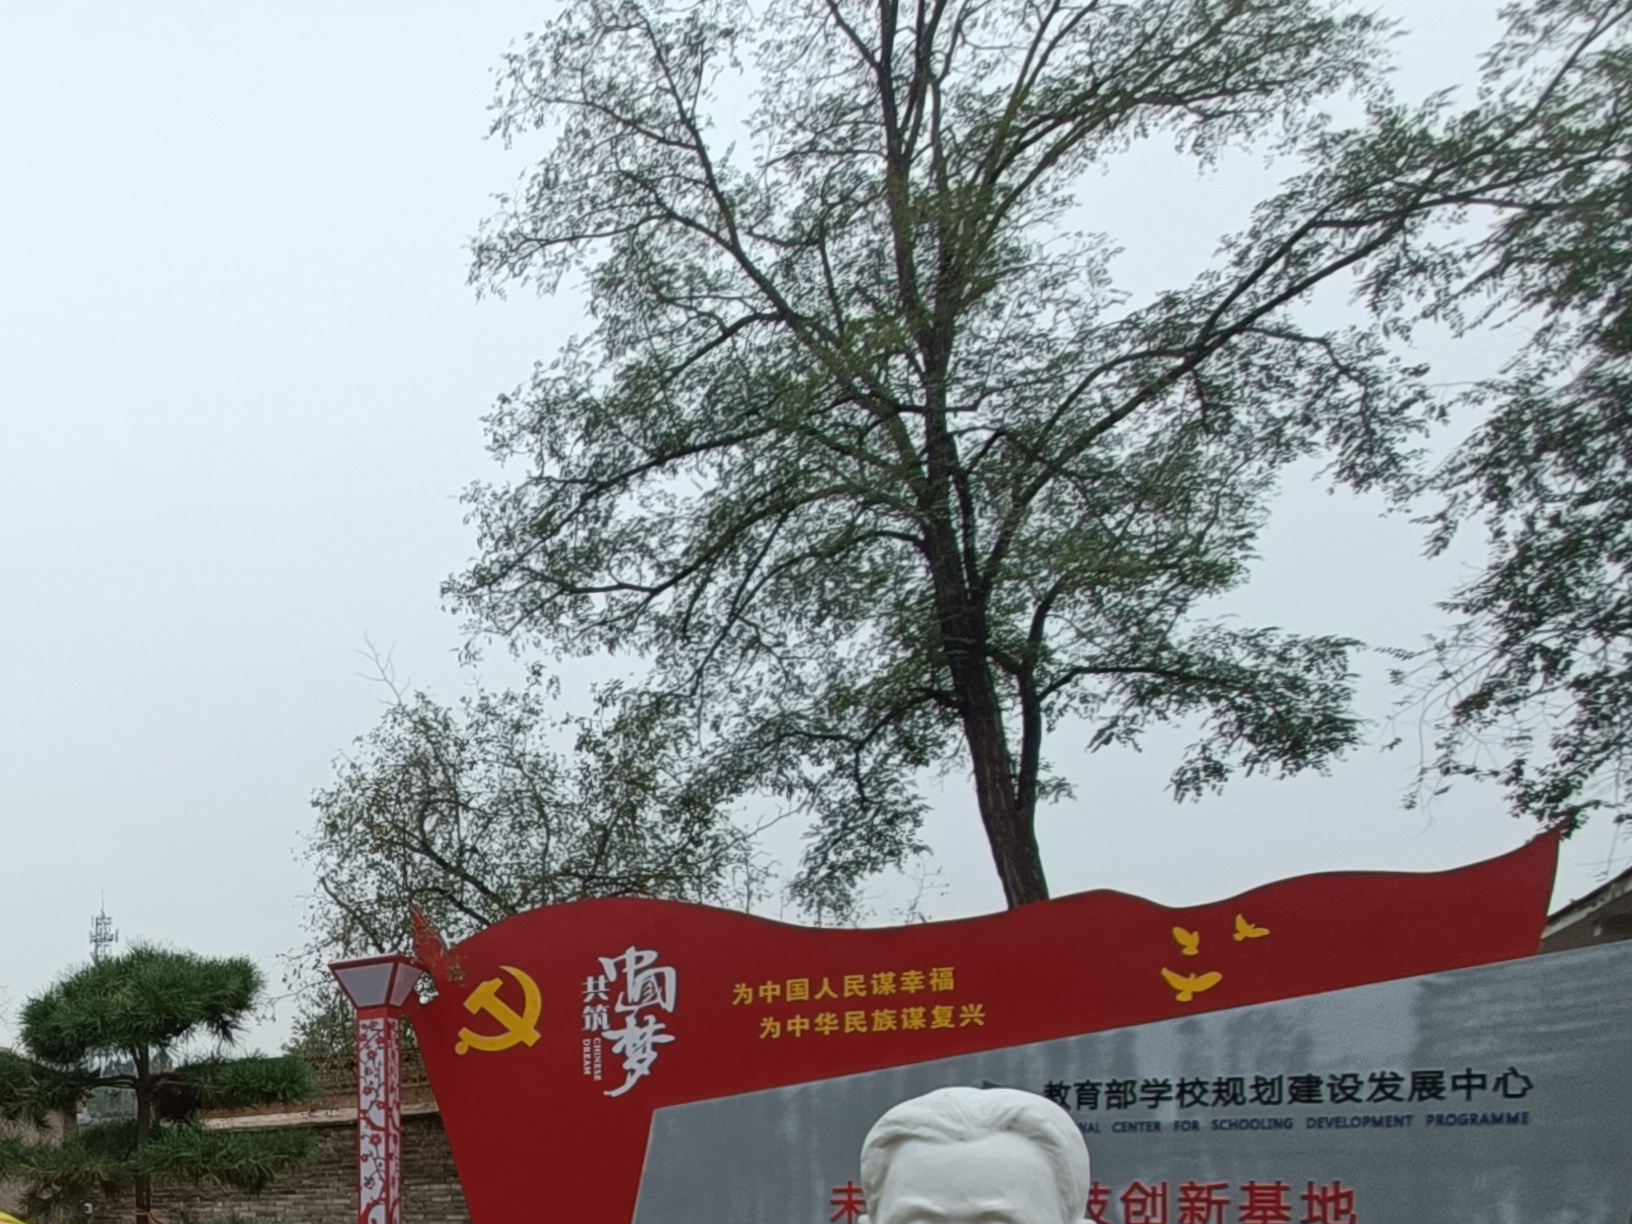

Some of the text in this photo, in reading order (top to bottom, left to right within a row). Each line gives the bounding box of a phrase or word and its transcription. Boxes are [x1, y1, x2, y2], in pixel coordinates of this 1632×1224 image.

[582, 975, 610, 1031] 共筑
[732, 967, 954, 1005] 为中国人民谋幸福
[759, 1003, 985, 1040] 为中华民族谋复兴
[582, 1038, 591, 1075] DREAM
[593, 1037, 602, 1081] CHINESE
[1043, 1066, 1534, 1111] 教育部学校规划建设发展中心
[1112, 1121, 1162, 1133] CENTER
[1173, 1120, 1200, 1132] FOR
[1211, 1117, 1294, 1131] SCHOOLING
[1306, 1114, 1414, 1130] DEVELOPMENT
[1425, 1111, 1530, 1127] PROGRAMME
